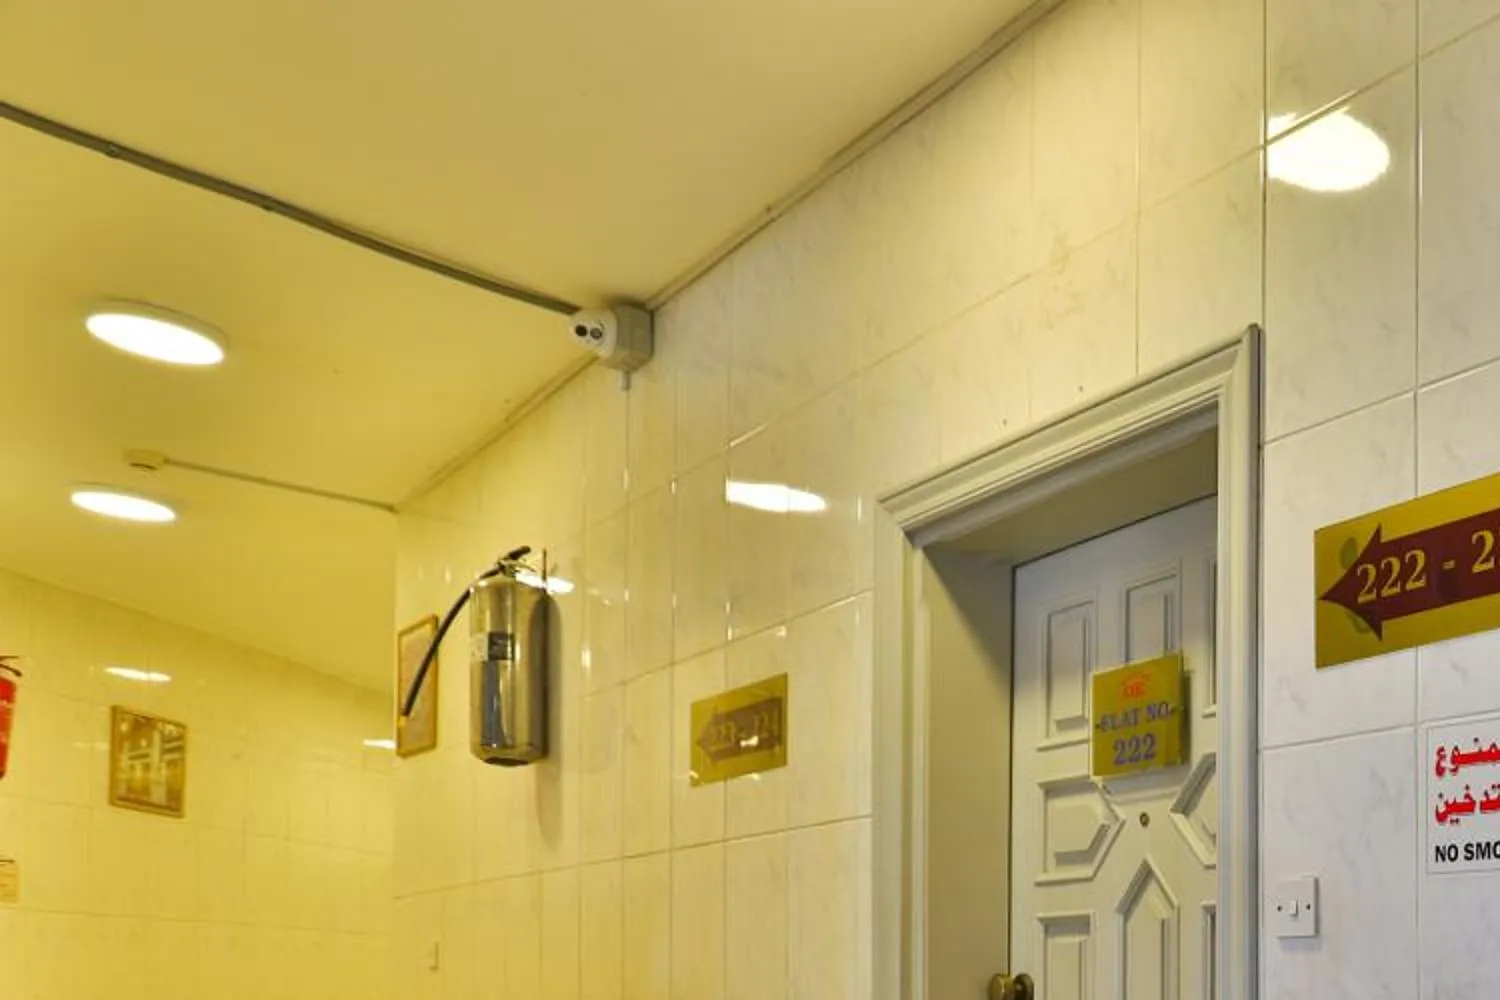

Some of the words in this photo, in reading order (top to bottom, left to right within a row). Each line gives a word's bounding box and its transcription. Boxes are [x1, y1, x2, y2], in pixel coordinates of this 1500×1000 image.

[1356, 550, 1426, 605] 222
[1113, 733, 1156, 765] 222
[1435, 844, 1459, 863] NO
